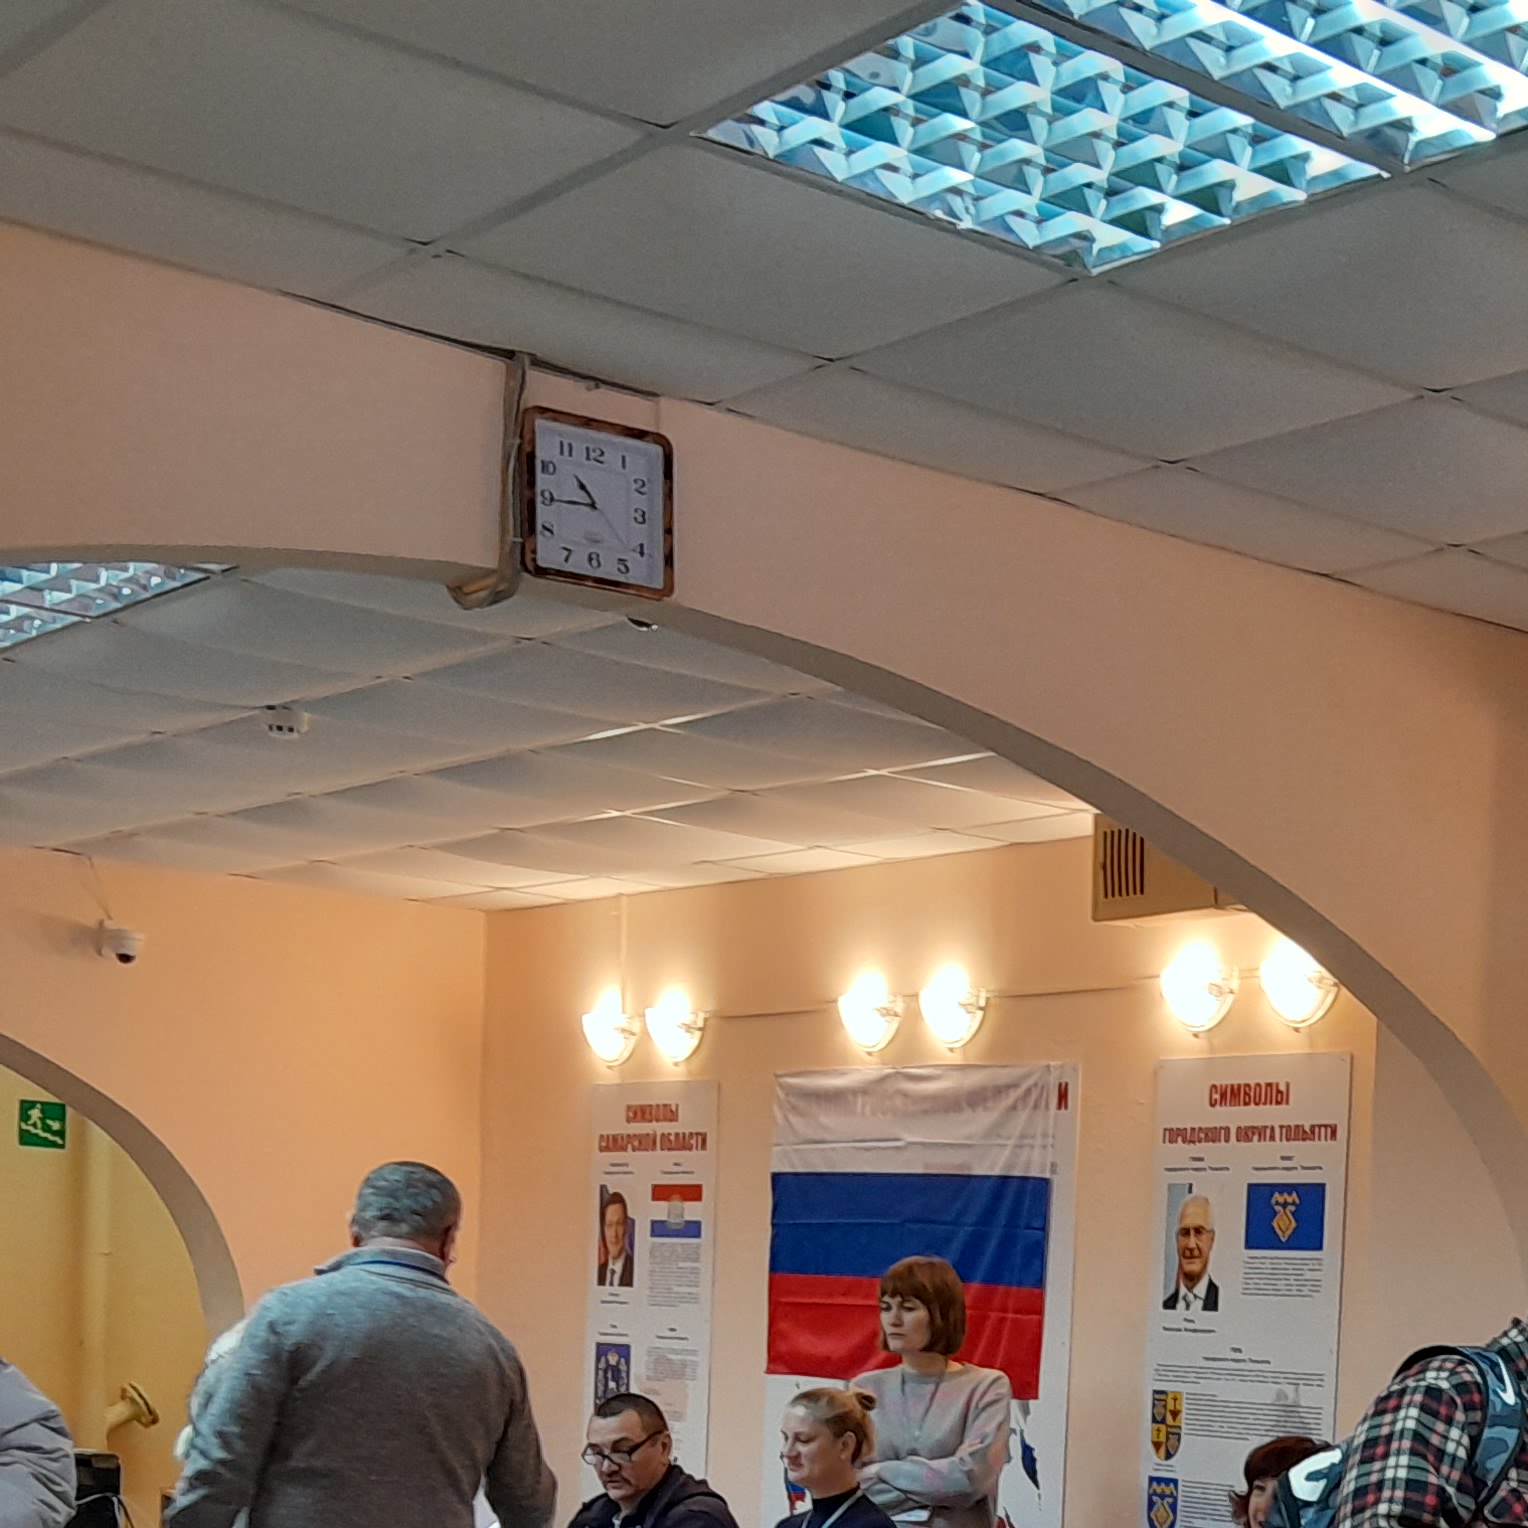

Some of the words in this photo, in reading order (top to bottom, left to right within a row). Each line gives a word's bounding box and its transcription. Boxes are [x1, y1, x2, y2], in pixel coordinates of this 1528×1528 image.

[559, 440, 573, 458] 11
[585, 446, 605, 464] 12
[541, 460, 556, 475] 10
[633, 478, 647, 495] 2
[540, 489, 554, 506] 9
[634, 508, 646, 525] 3
[560, 547, 572, 563] 7
[632, 543, 645, 558] 4
[587, 552, 602, 569] 6
[617, 558, 630, 575] 5
[1208, 1082, 1290, 1107] СИМВОЛЫ
[1163, 1126, 1230, 1145] ГОРОДСКОГО
[1236, 1125, 1275, 1142] ОКРУГА
[1279, 1123, 1337, 1142] ТОЛЬЯТТИ
